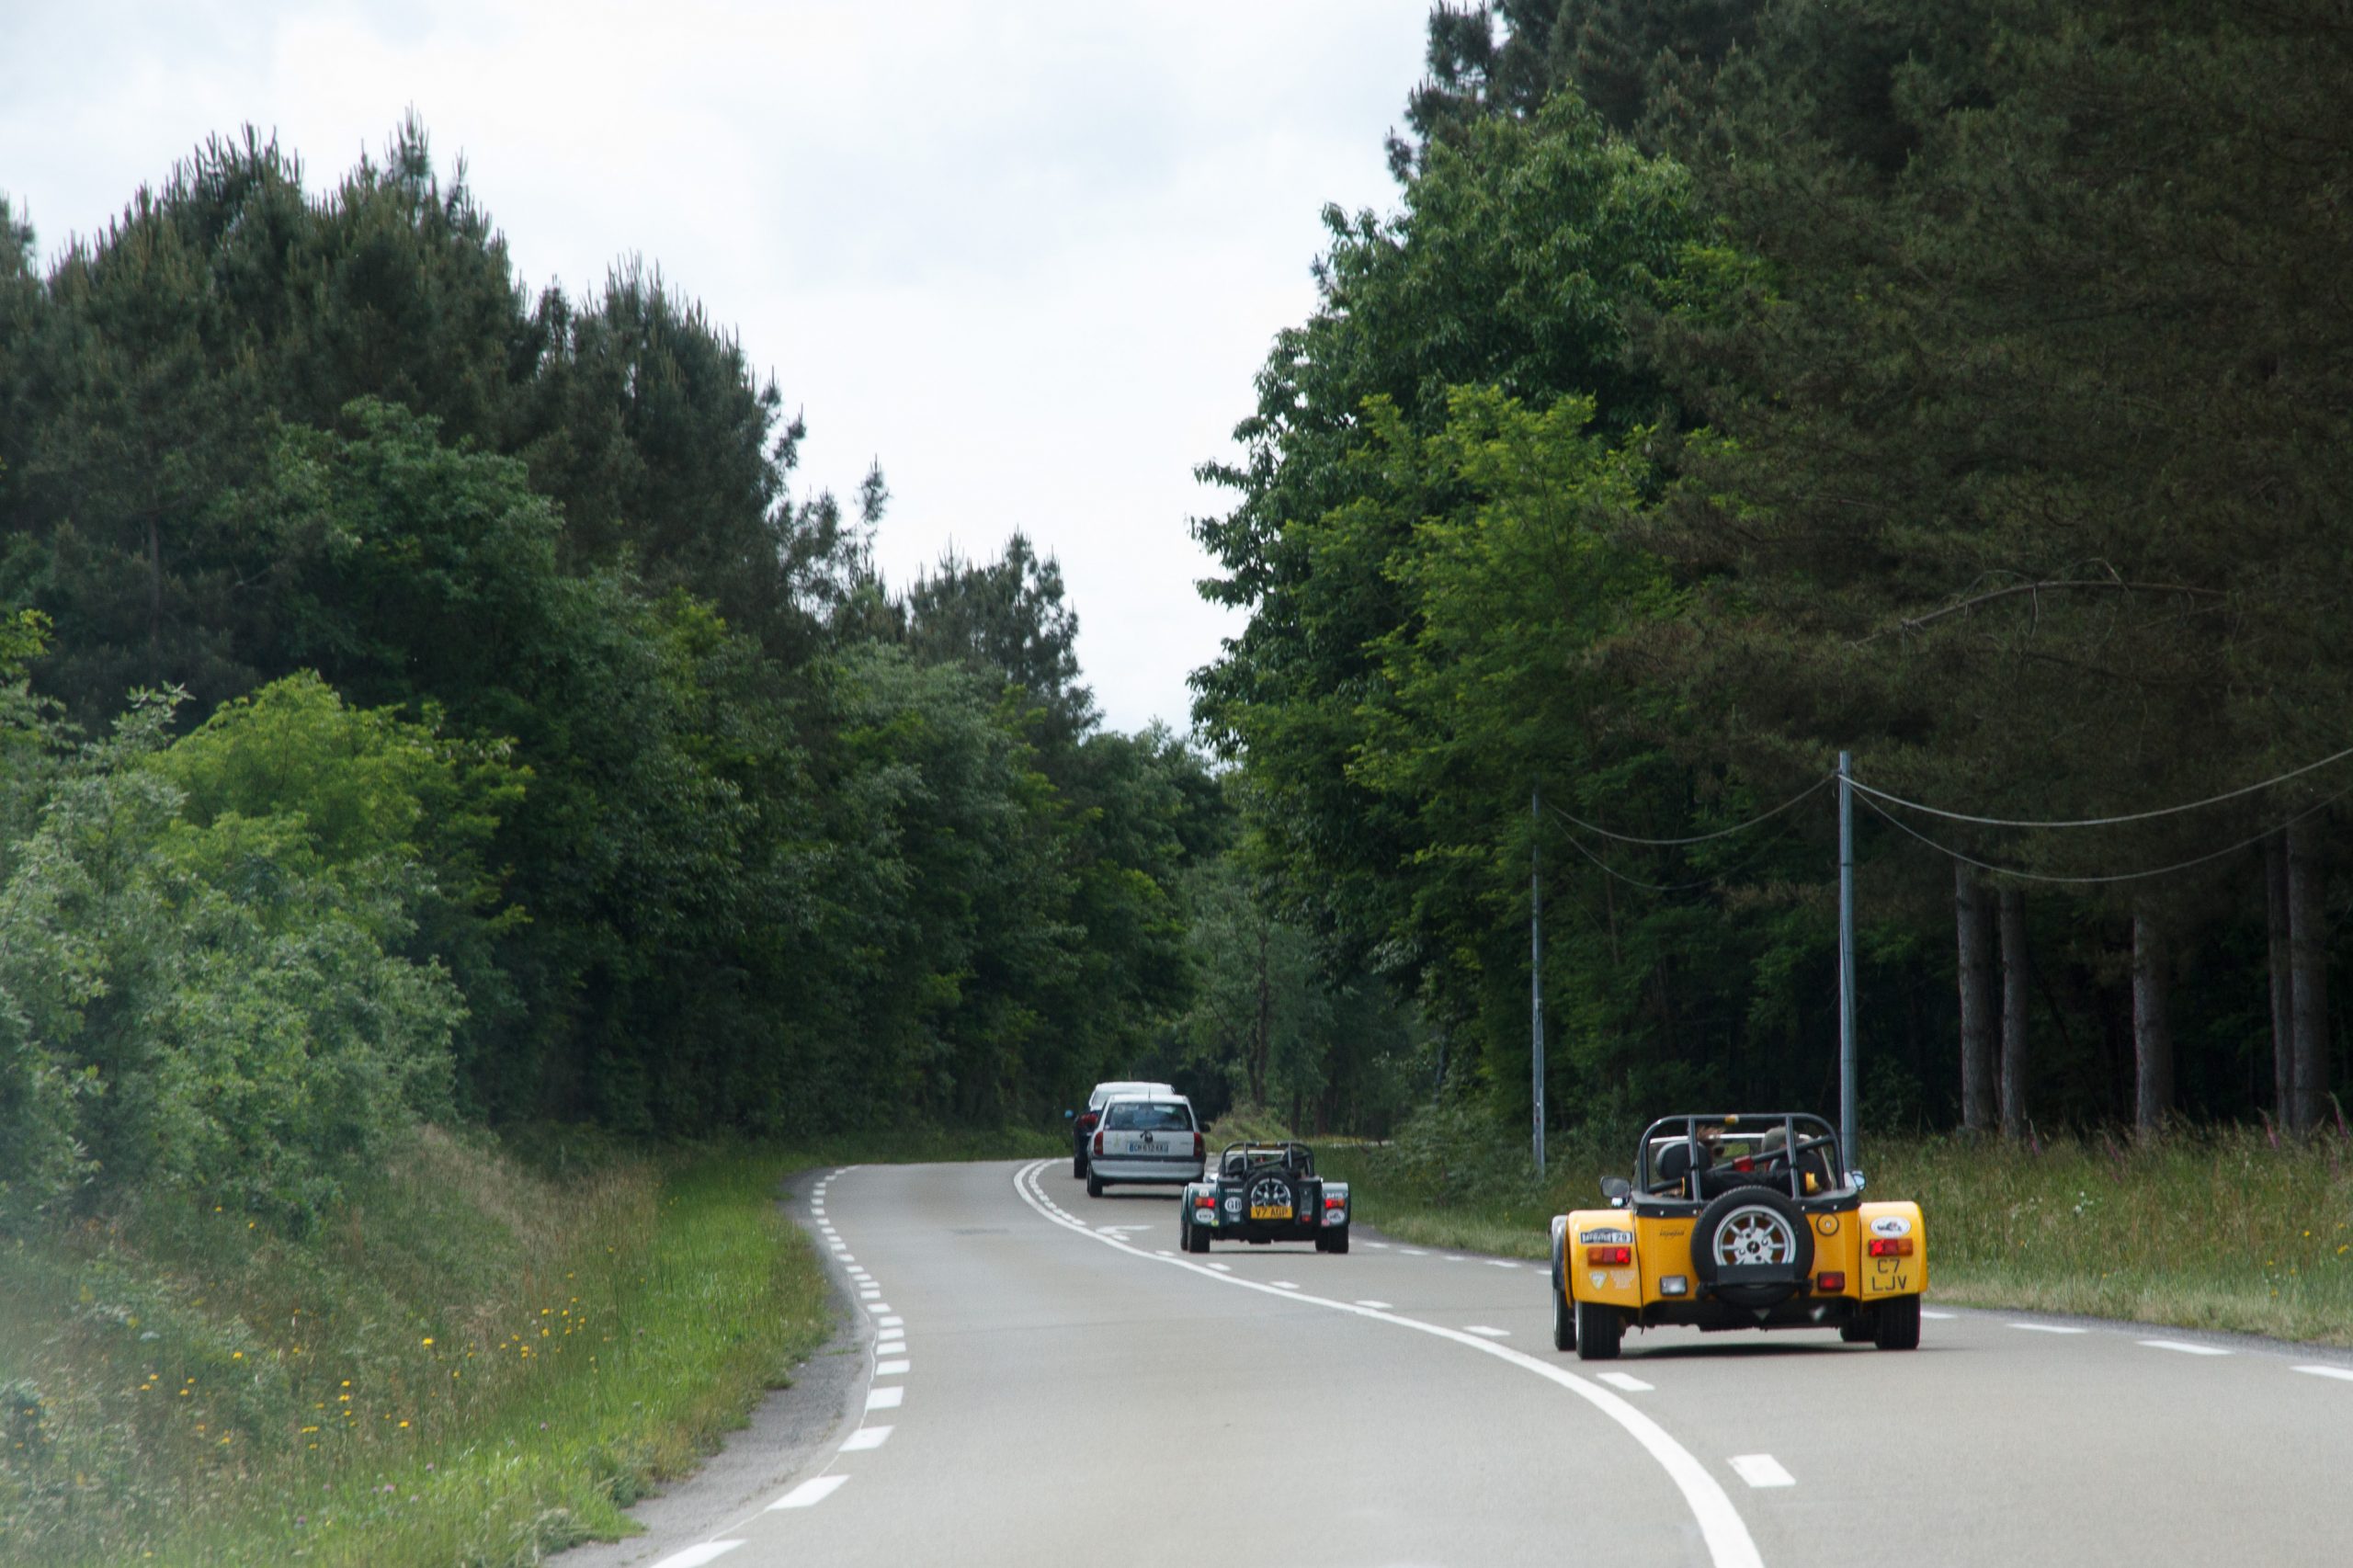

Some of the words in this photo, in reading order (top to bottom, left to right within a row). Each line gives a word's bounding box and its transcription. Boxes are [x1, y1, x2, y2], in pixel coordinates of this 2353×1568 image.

[1227, 1198, 1241, 1211] GB
[1877, 1257, 1900, 1274] C7
[1871, 1275, 1907, 1291] LJV
